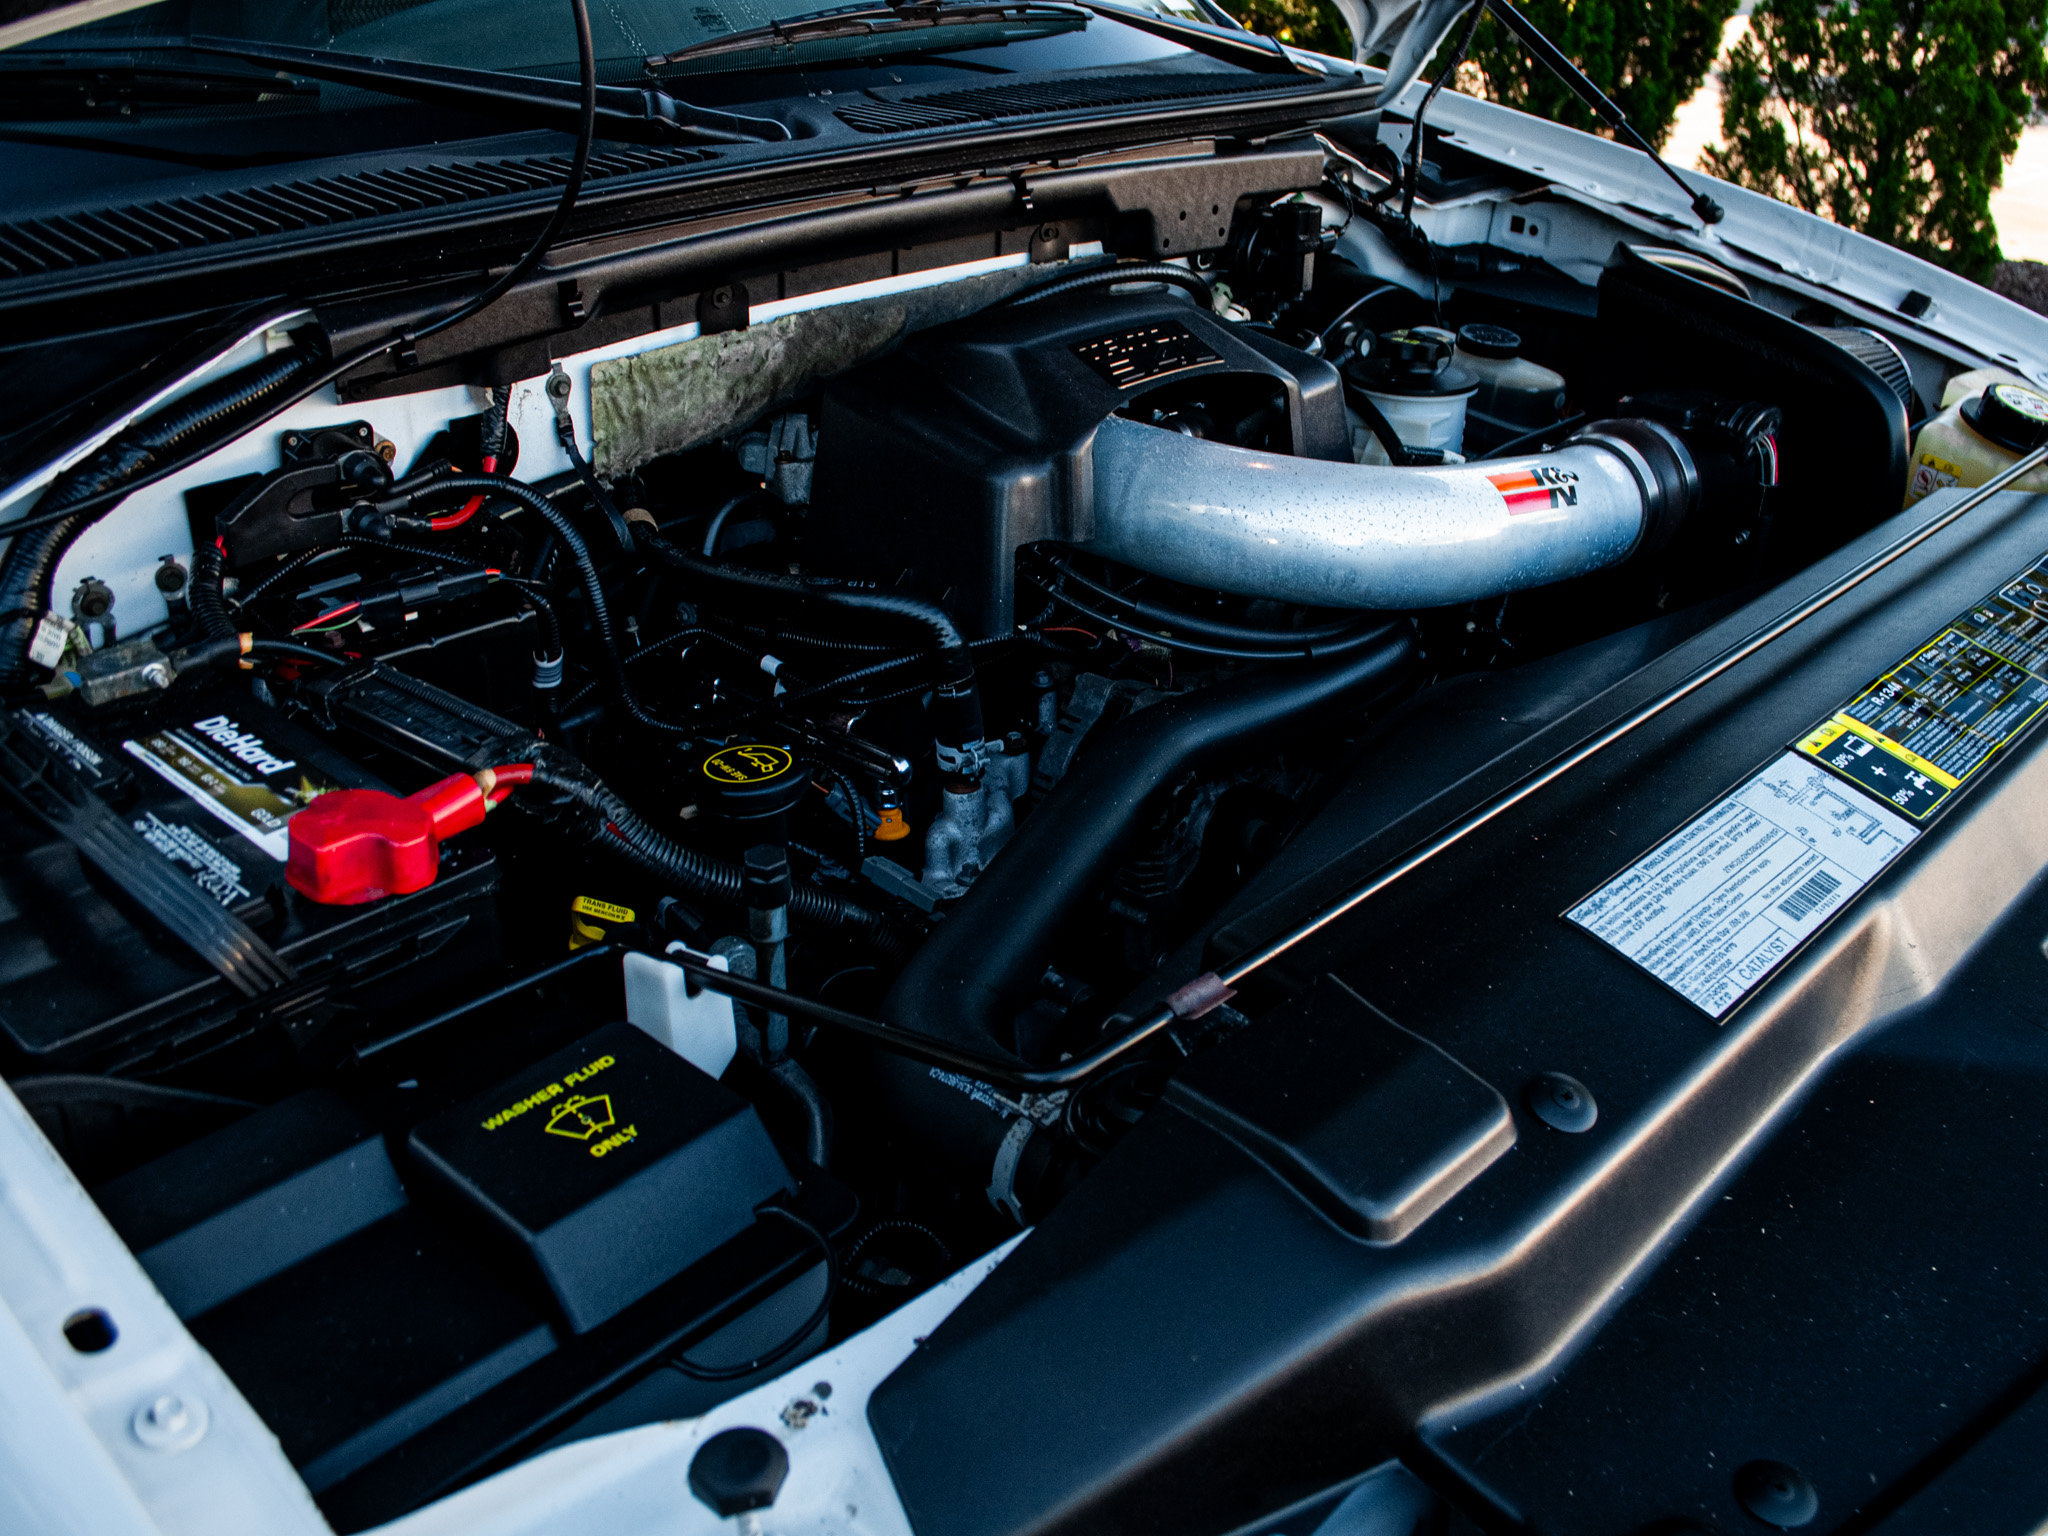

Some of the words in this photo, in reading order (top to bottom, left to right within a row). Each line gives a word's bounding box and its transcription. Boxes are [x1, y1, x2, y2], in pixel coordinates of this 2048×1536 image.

[1870, 682, 1904, 707] R-134A
[193, 714, 297, 776] DieHard
[1831, 752, 1856, 769] 50%
[1891, 787, 1915, 806] 50%
[250, 807, 282, 829] GOLD
[583, 897, 607, 910] TRANS
[607, 904, 629, 916] FLUID
[1736, 936, 1790, 980] CATALYST
[481, 1082, 565, 1131] WASHER
[563, 1054, 616, 1088] FLUID
[589, 1123, 638, 1158] ONLY
